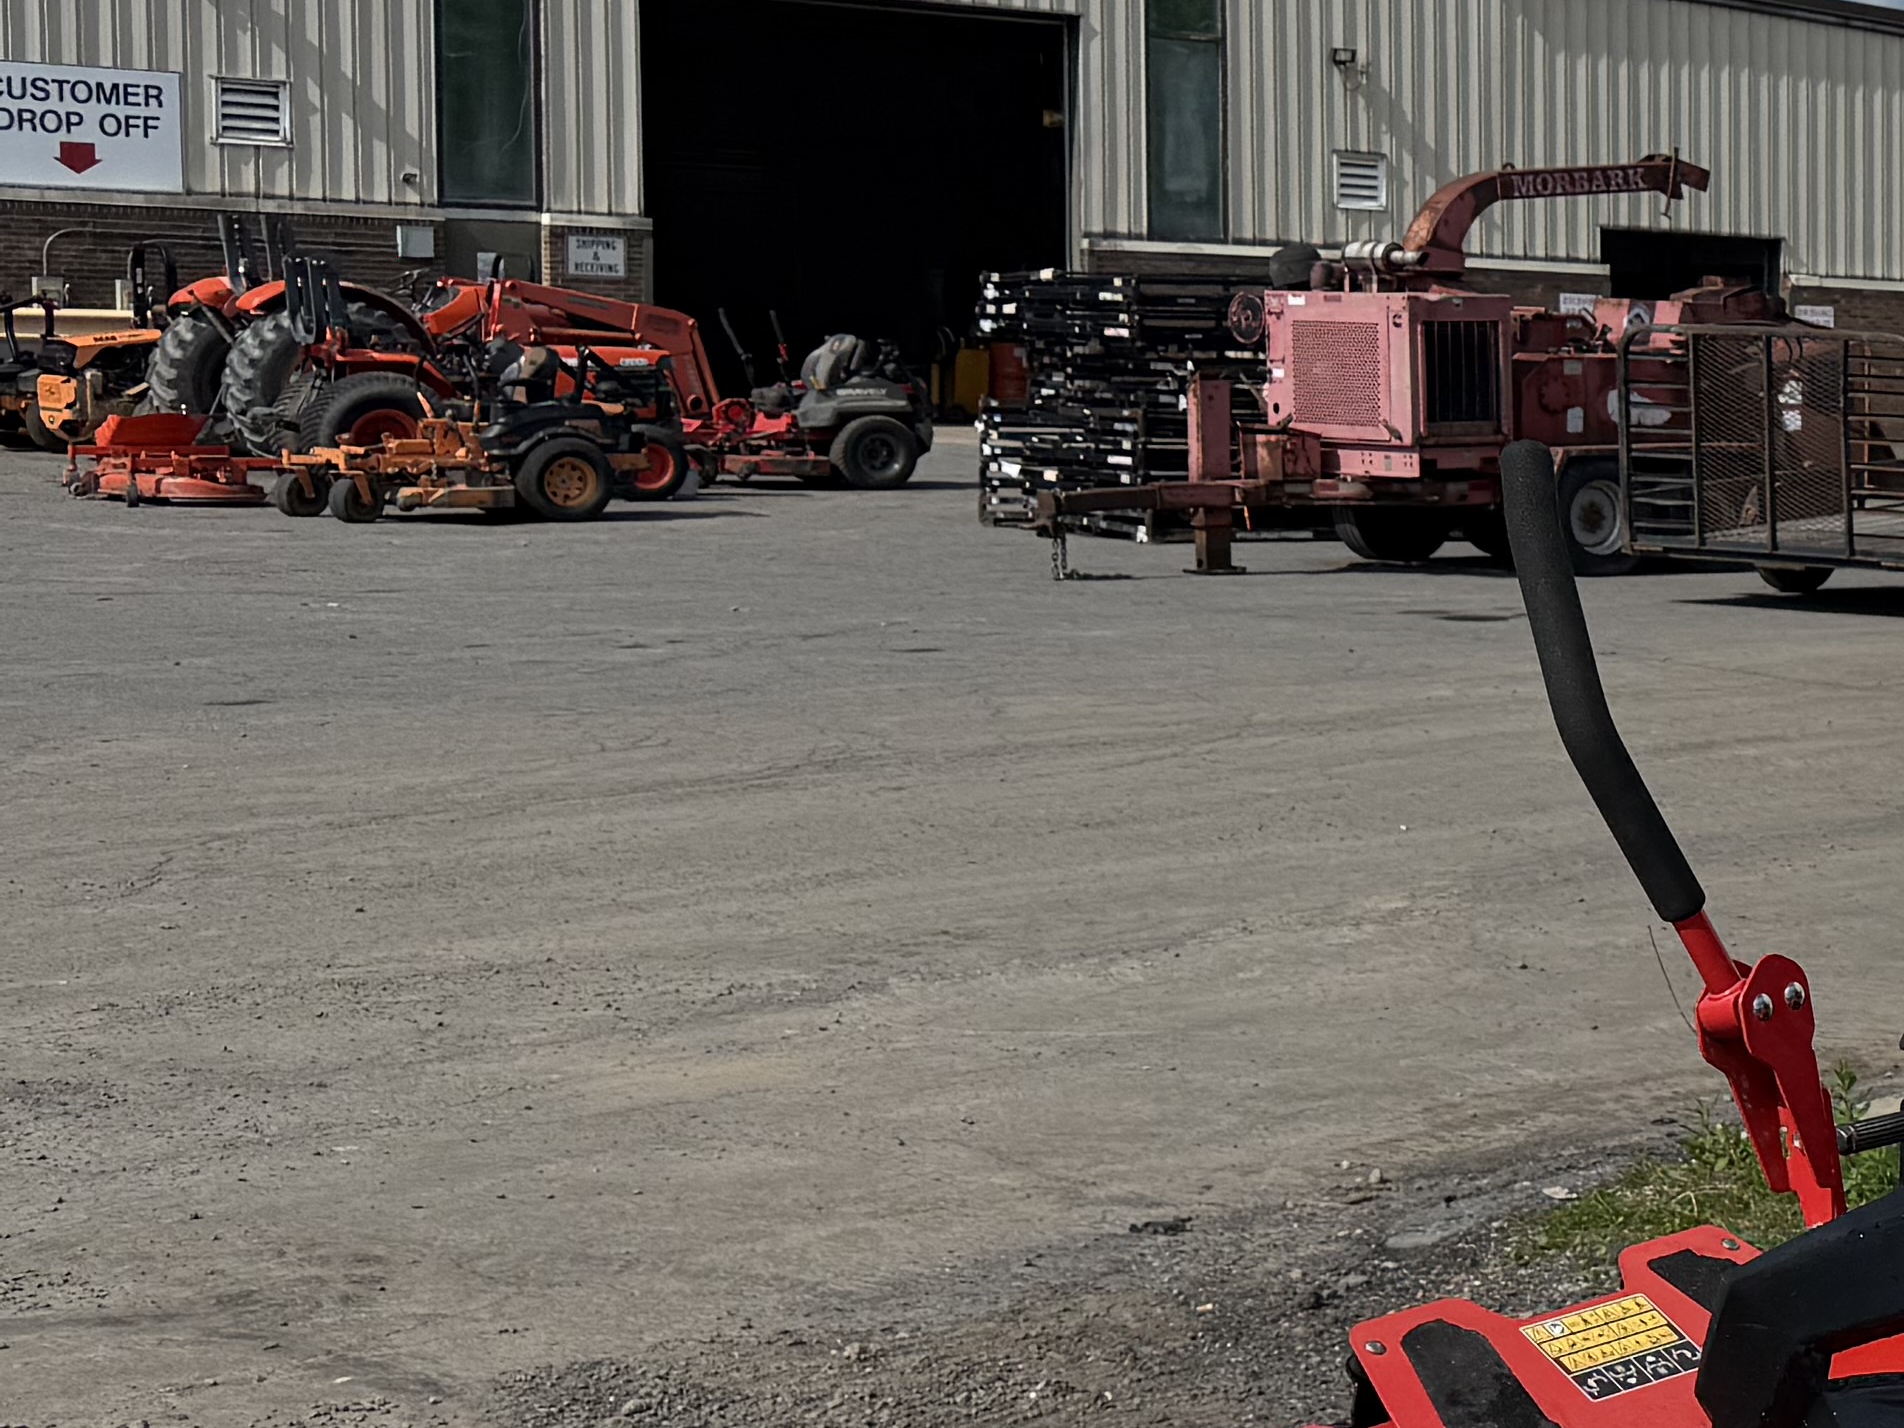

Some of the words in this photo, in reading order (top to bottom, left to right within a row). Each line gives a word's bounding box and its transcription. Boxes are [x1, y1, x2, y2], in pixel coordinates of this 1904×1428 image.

[0, 75, 164, 109] USTOMER
[99, 113, 161, 139] OFF
[1511, 167, 1648, 197] MORBARK
